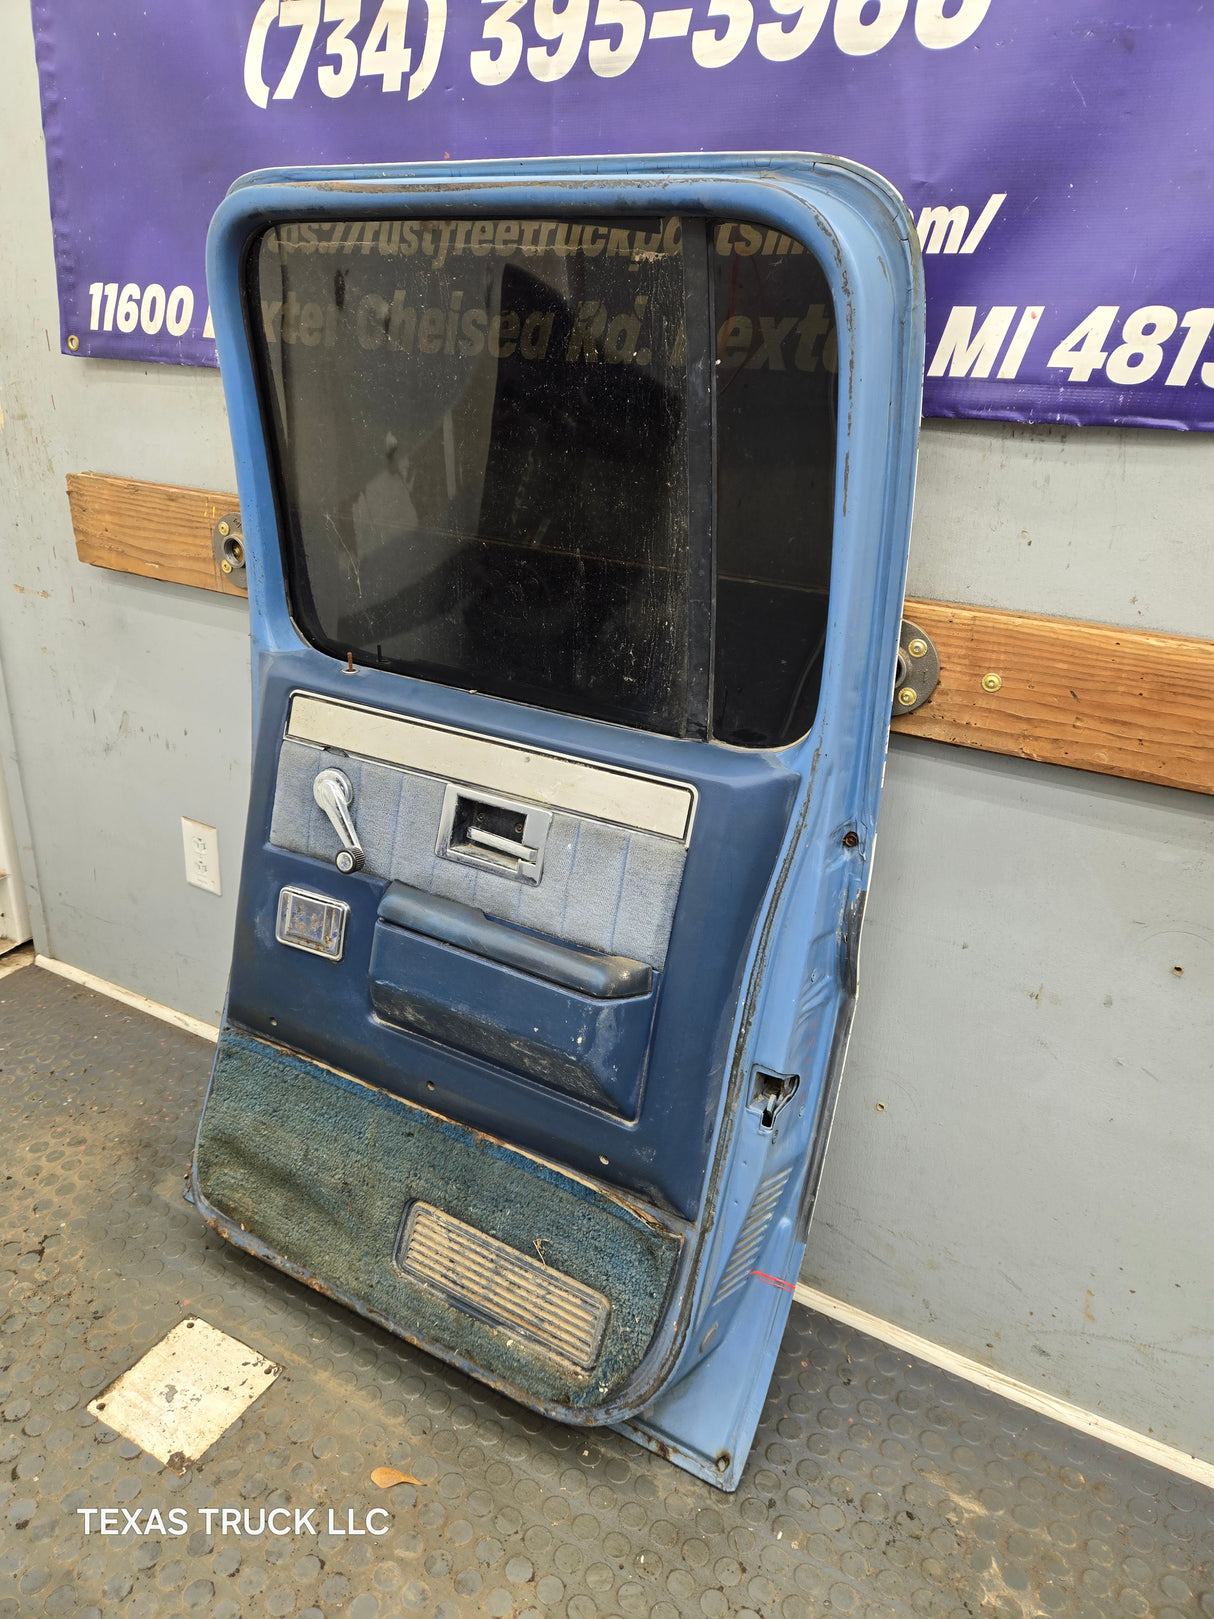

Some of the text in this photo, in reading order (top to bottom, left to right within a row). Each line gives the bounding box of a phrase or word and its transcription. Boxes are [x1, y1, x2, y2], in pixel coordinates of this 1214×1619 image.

[244, 0, 447, 110] (734)
[89, 282, 194, 337] 11600
[203, 291, 337, 347] xter
[357, 289, 555, 359] Chelsea
[566, 295, 652, 366] Rd.
[927, 305, 1045, 379] MI
[1047, 305, 1214, 389] 481
